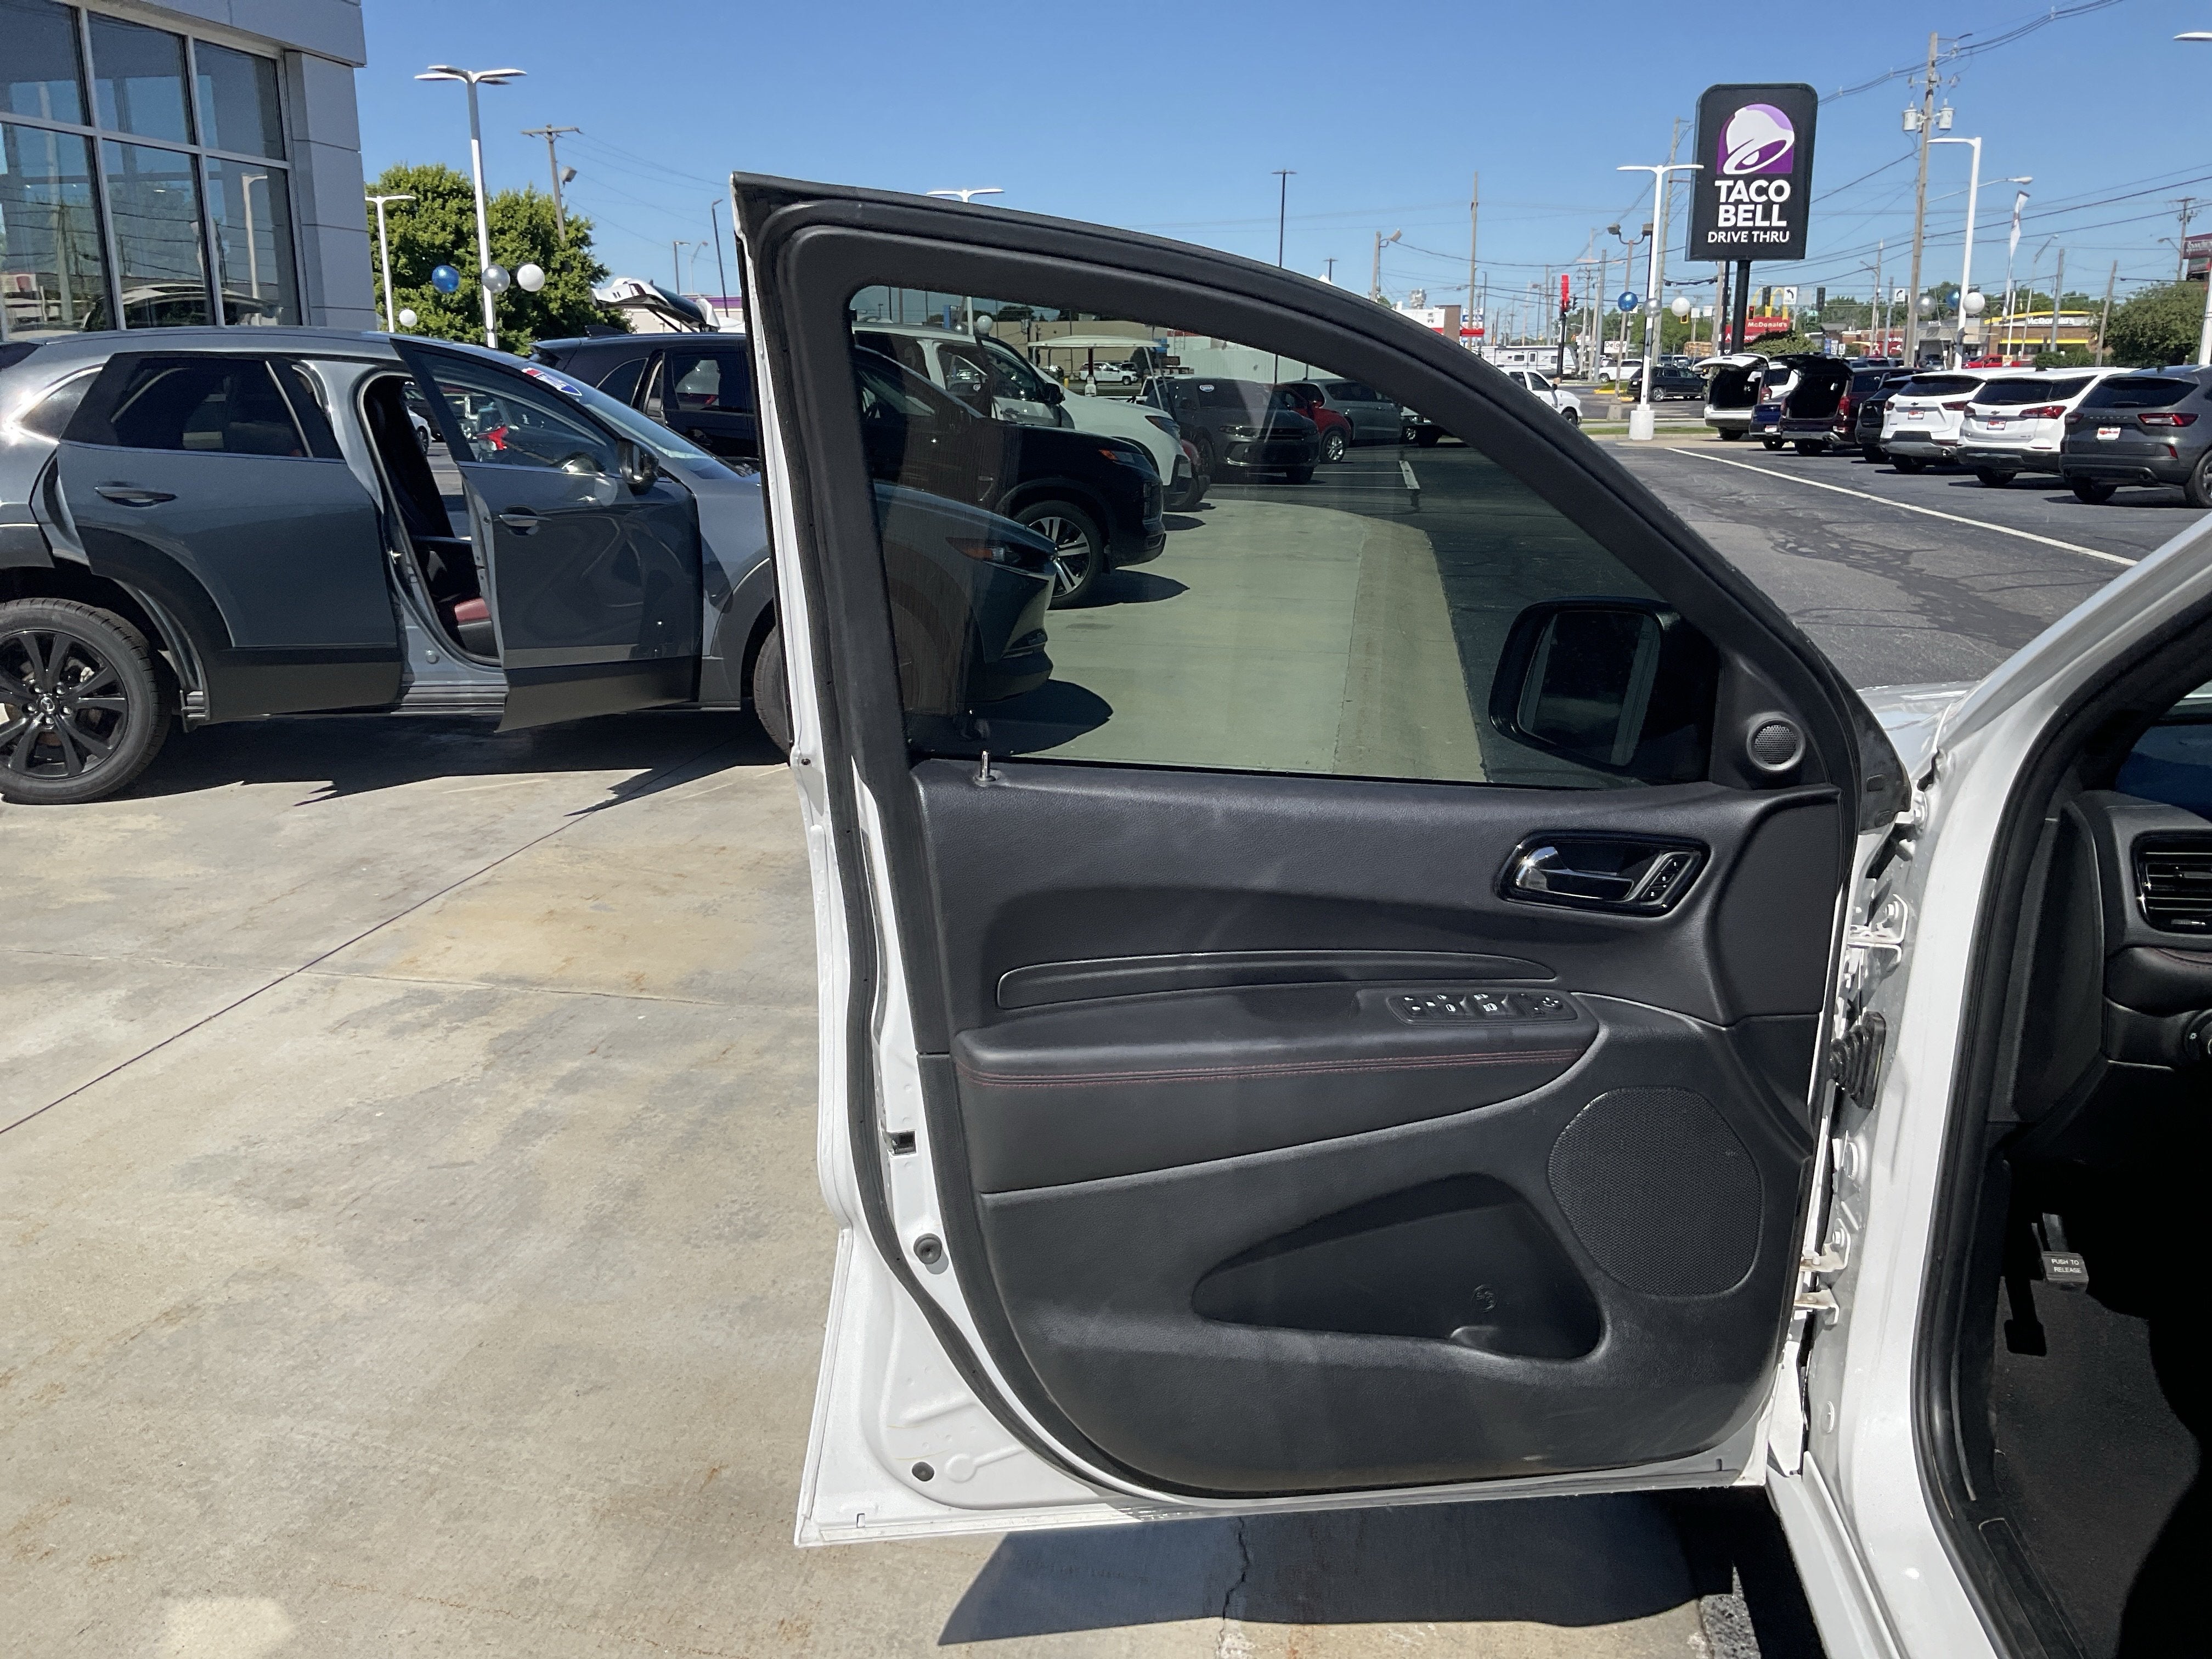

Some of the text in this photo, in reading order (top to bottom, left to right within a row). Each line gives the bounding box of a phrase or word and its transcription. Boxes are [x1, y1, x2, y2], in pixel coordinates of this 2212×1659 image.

[1714, 179, 1791, 202] TACO
[1718, 204, 1787, 227] BELL
[1707, 230, 1790, 243] DRIVE THRU
